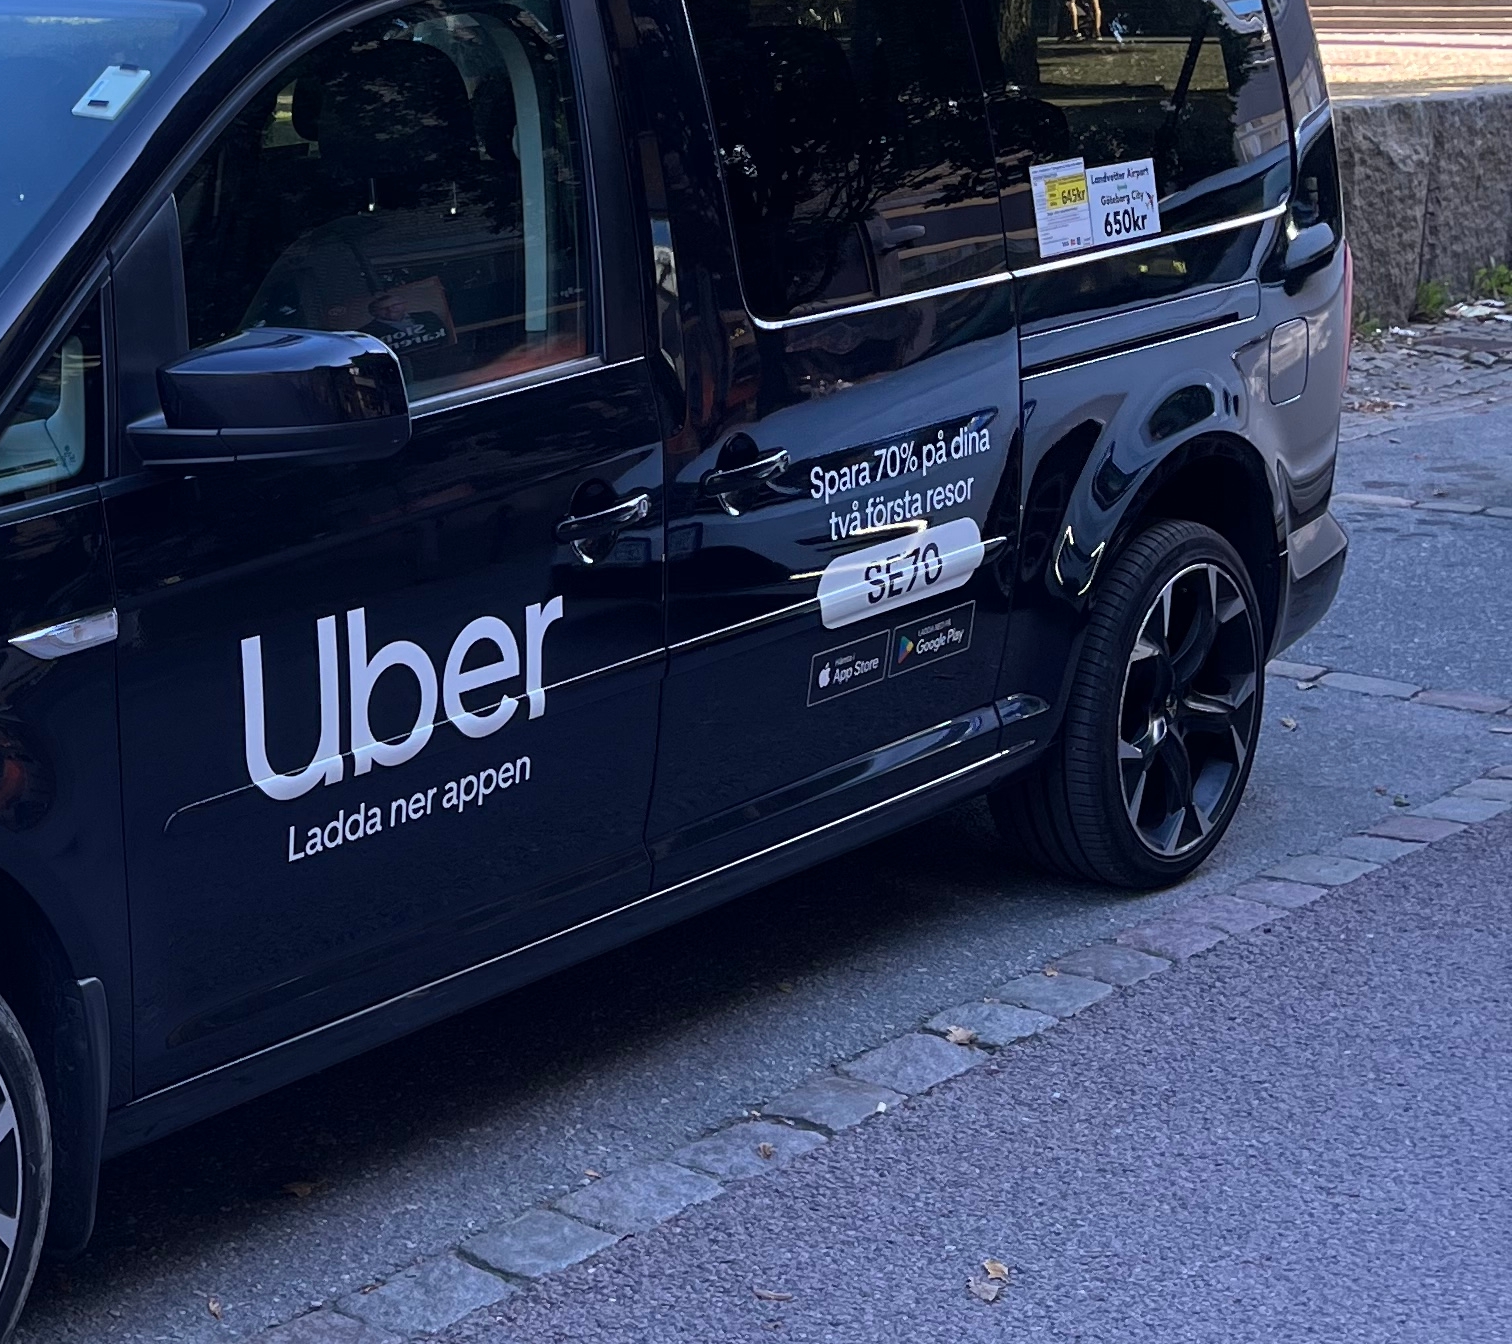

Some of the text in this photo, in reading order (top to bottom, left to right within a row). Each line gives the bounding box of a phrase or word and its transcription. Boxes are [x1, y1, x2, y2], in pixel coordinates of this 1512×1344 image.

[1090, 171, 1125, 184] Landvetter
[1127, 166, 1149, 179] Airport
[1100, 190, 1144, 206] Göteborg City
[1104, 207, 1148, 237] 650kr
[810, 427, 990, 504] Spara 70% på dina
[829, 477, 975, 541] två första resor
[864, 542, 943, 604] SE70
[916, 627, 965, 654] Google Play
[832, 657, 879, 684] App Store
[241, 595, 563, 800] Uber
[288, 756, 531, 862] Ladda ner appen
